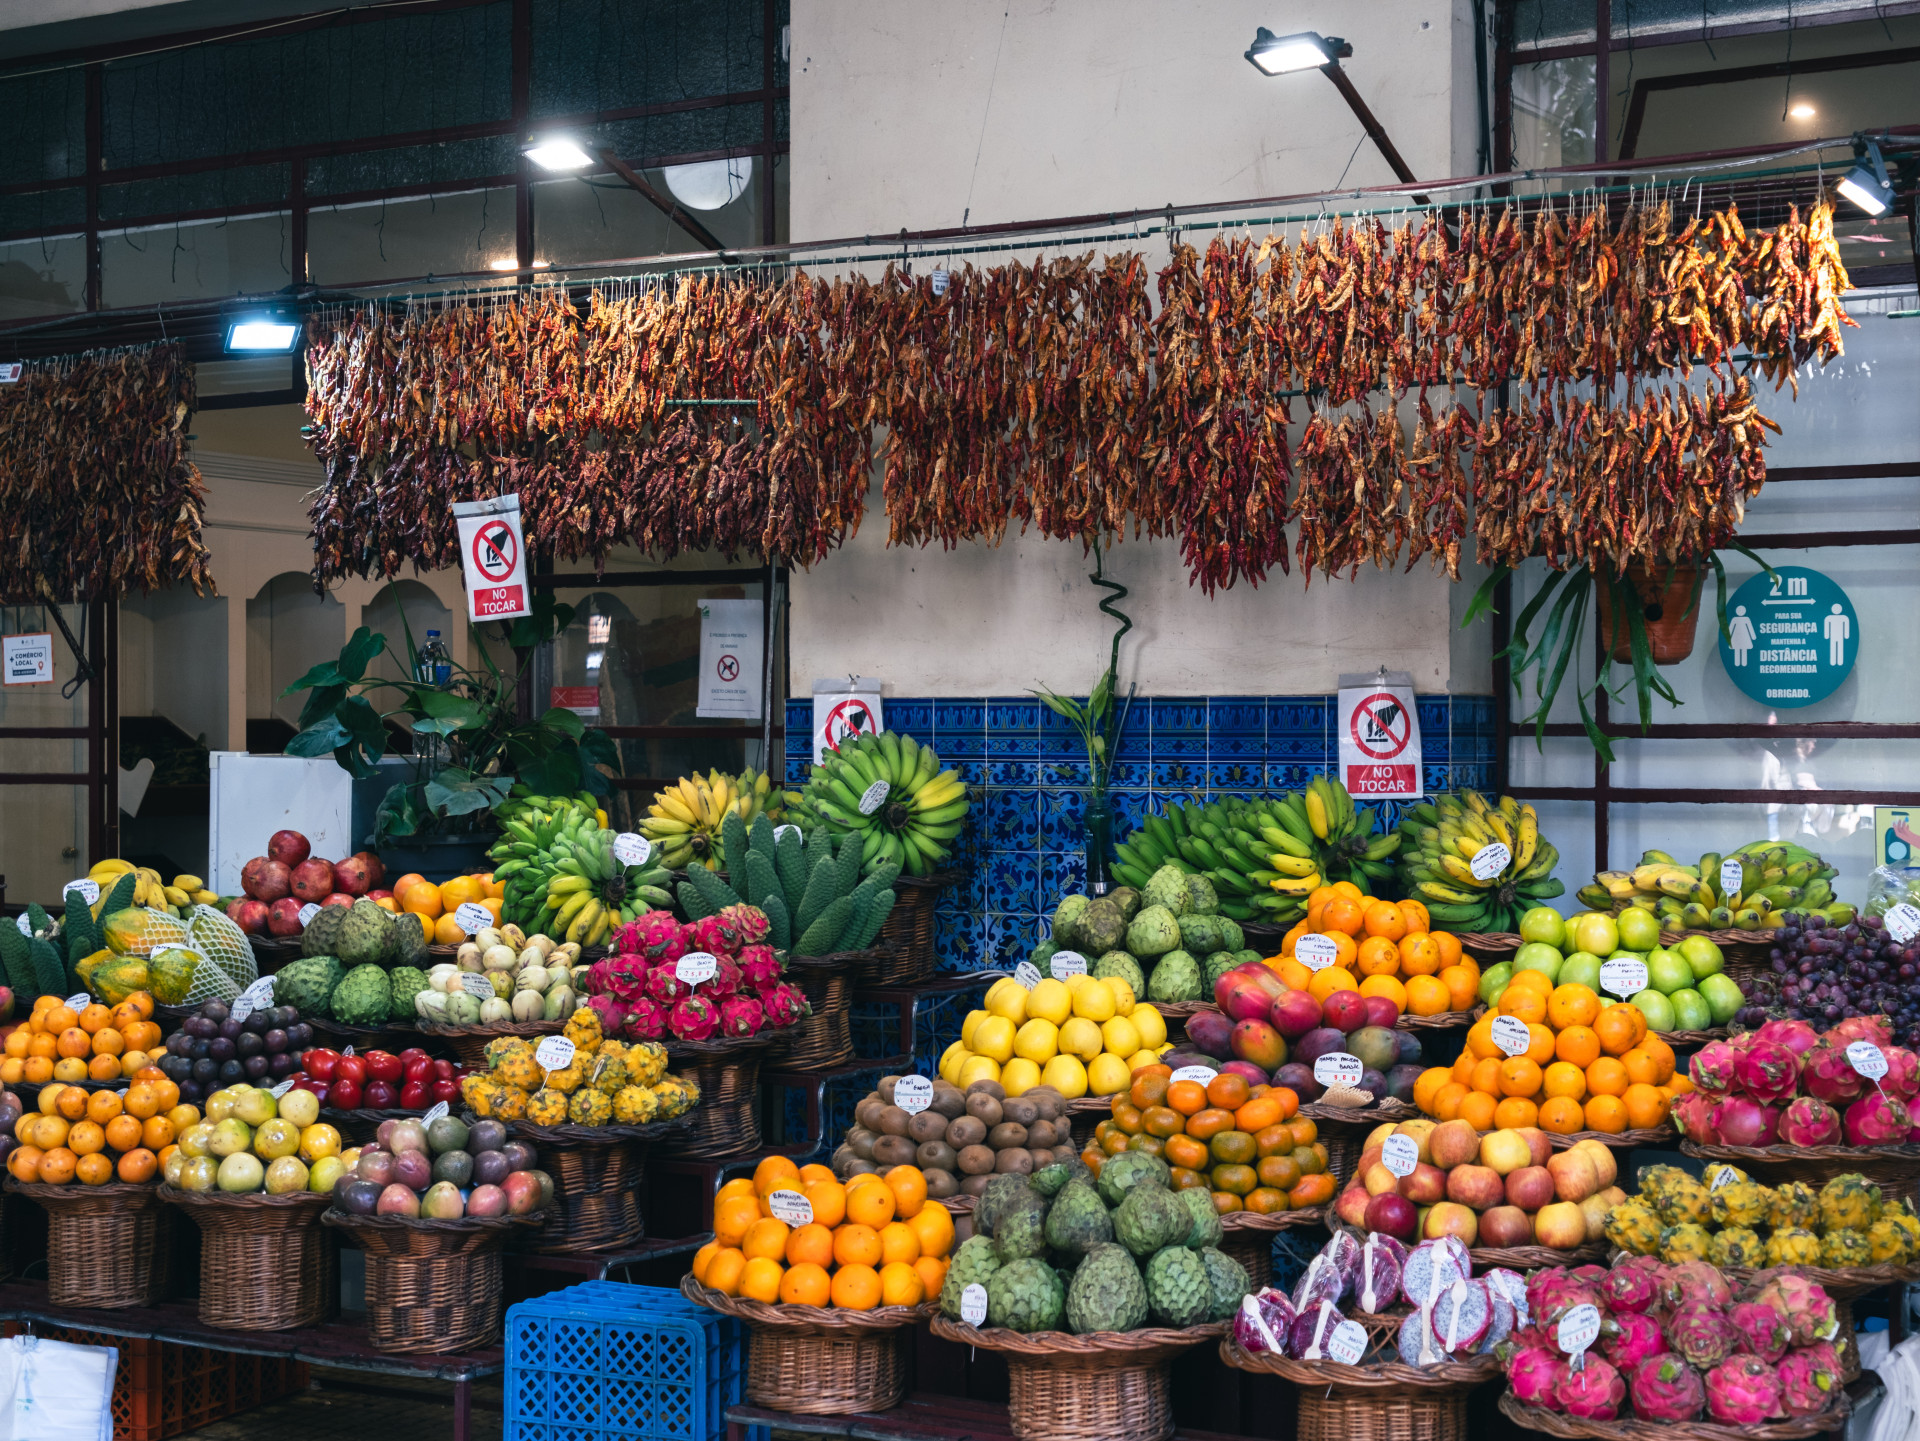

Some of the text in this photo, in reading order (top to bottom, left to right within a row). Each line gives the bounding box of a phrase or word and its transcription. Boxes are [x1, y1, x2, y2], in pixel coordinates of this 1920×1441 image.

[1769, 574, 1807, 596] 2 m
[493, 588, 507, 600] NO
[483, 600, 516, 614] TOCAR
[1775, 612, 1802, 620] PARA SUA
[1759, 622, 1818, 635] SEGURANÇA
[15, 651, 43, 660] COMÉRCIO
[1760, 647, 1818, 662] DISTÂNCIA
[1760, 664, 1818, 674] RECOMENDADA
[1766, 688, 1811, 698] OBRIGADO.
[1373, 767, 1393, 778] NO
[1359, 780, 1405, 792] TOCAR
[910, 1097, 927, 1106] 4,25
